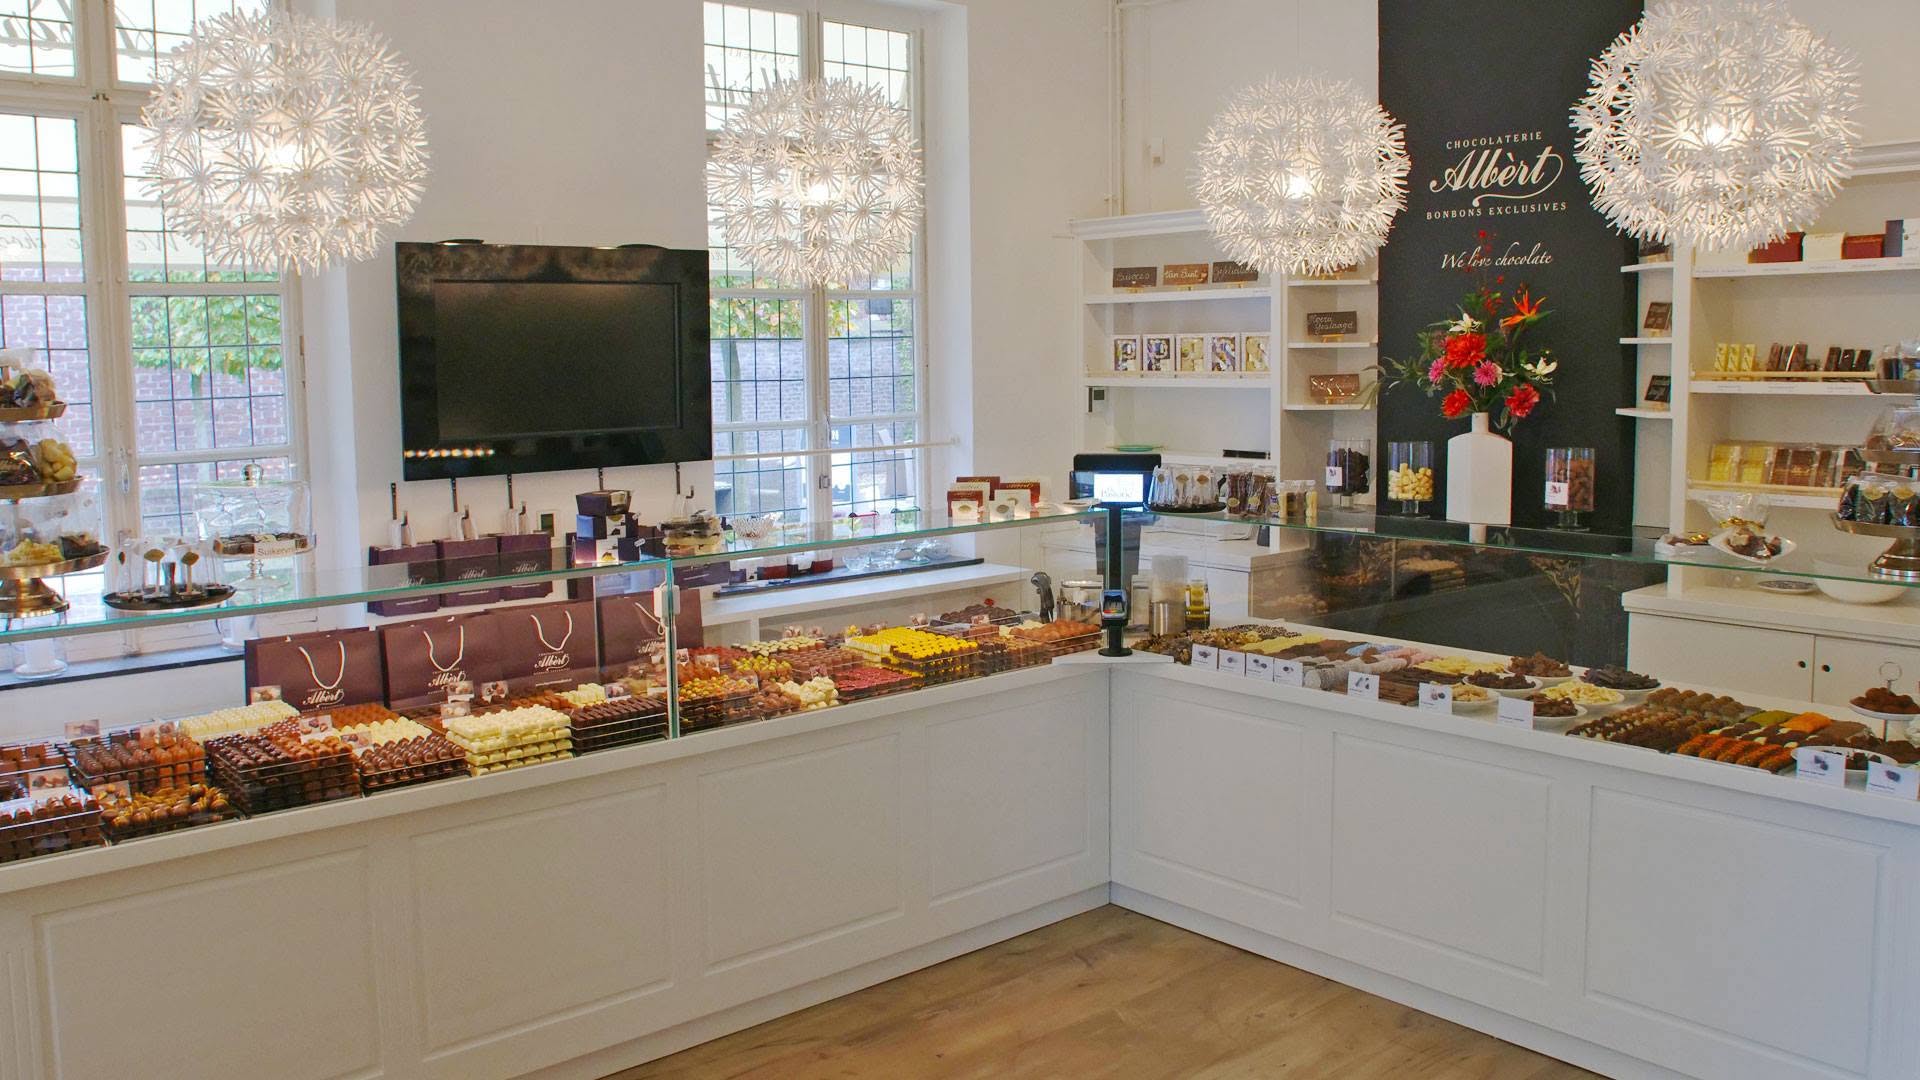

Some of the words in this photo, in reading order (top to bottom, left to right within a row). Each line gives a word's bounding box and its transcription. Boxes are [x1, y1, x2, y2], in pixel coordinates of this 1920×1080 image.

[1446, 131, 1543, 150] CHOCOLATERIE
[1429, 145, 1564, 207] Albèrt
[1426, 208, 1482, 221] BONBONS
[1488, 201, 1568, 217] EXCLUSIVES
[1441, 252, 1465, 269] We
[1466, 243, 1491, 268] love
[1495, 241, 1553, 267] chocolate
